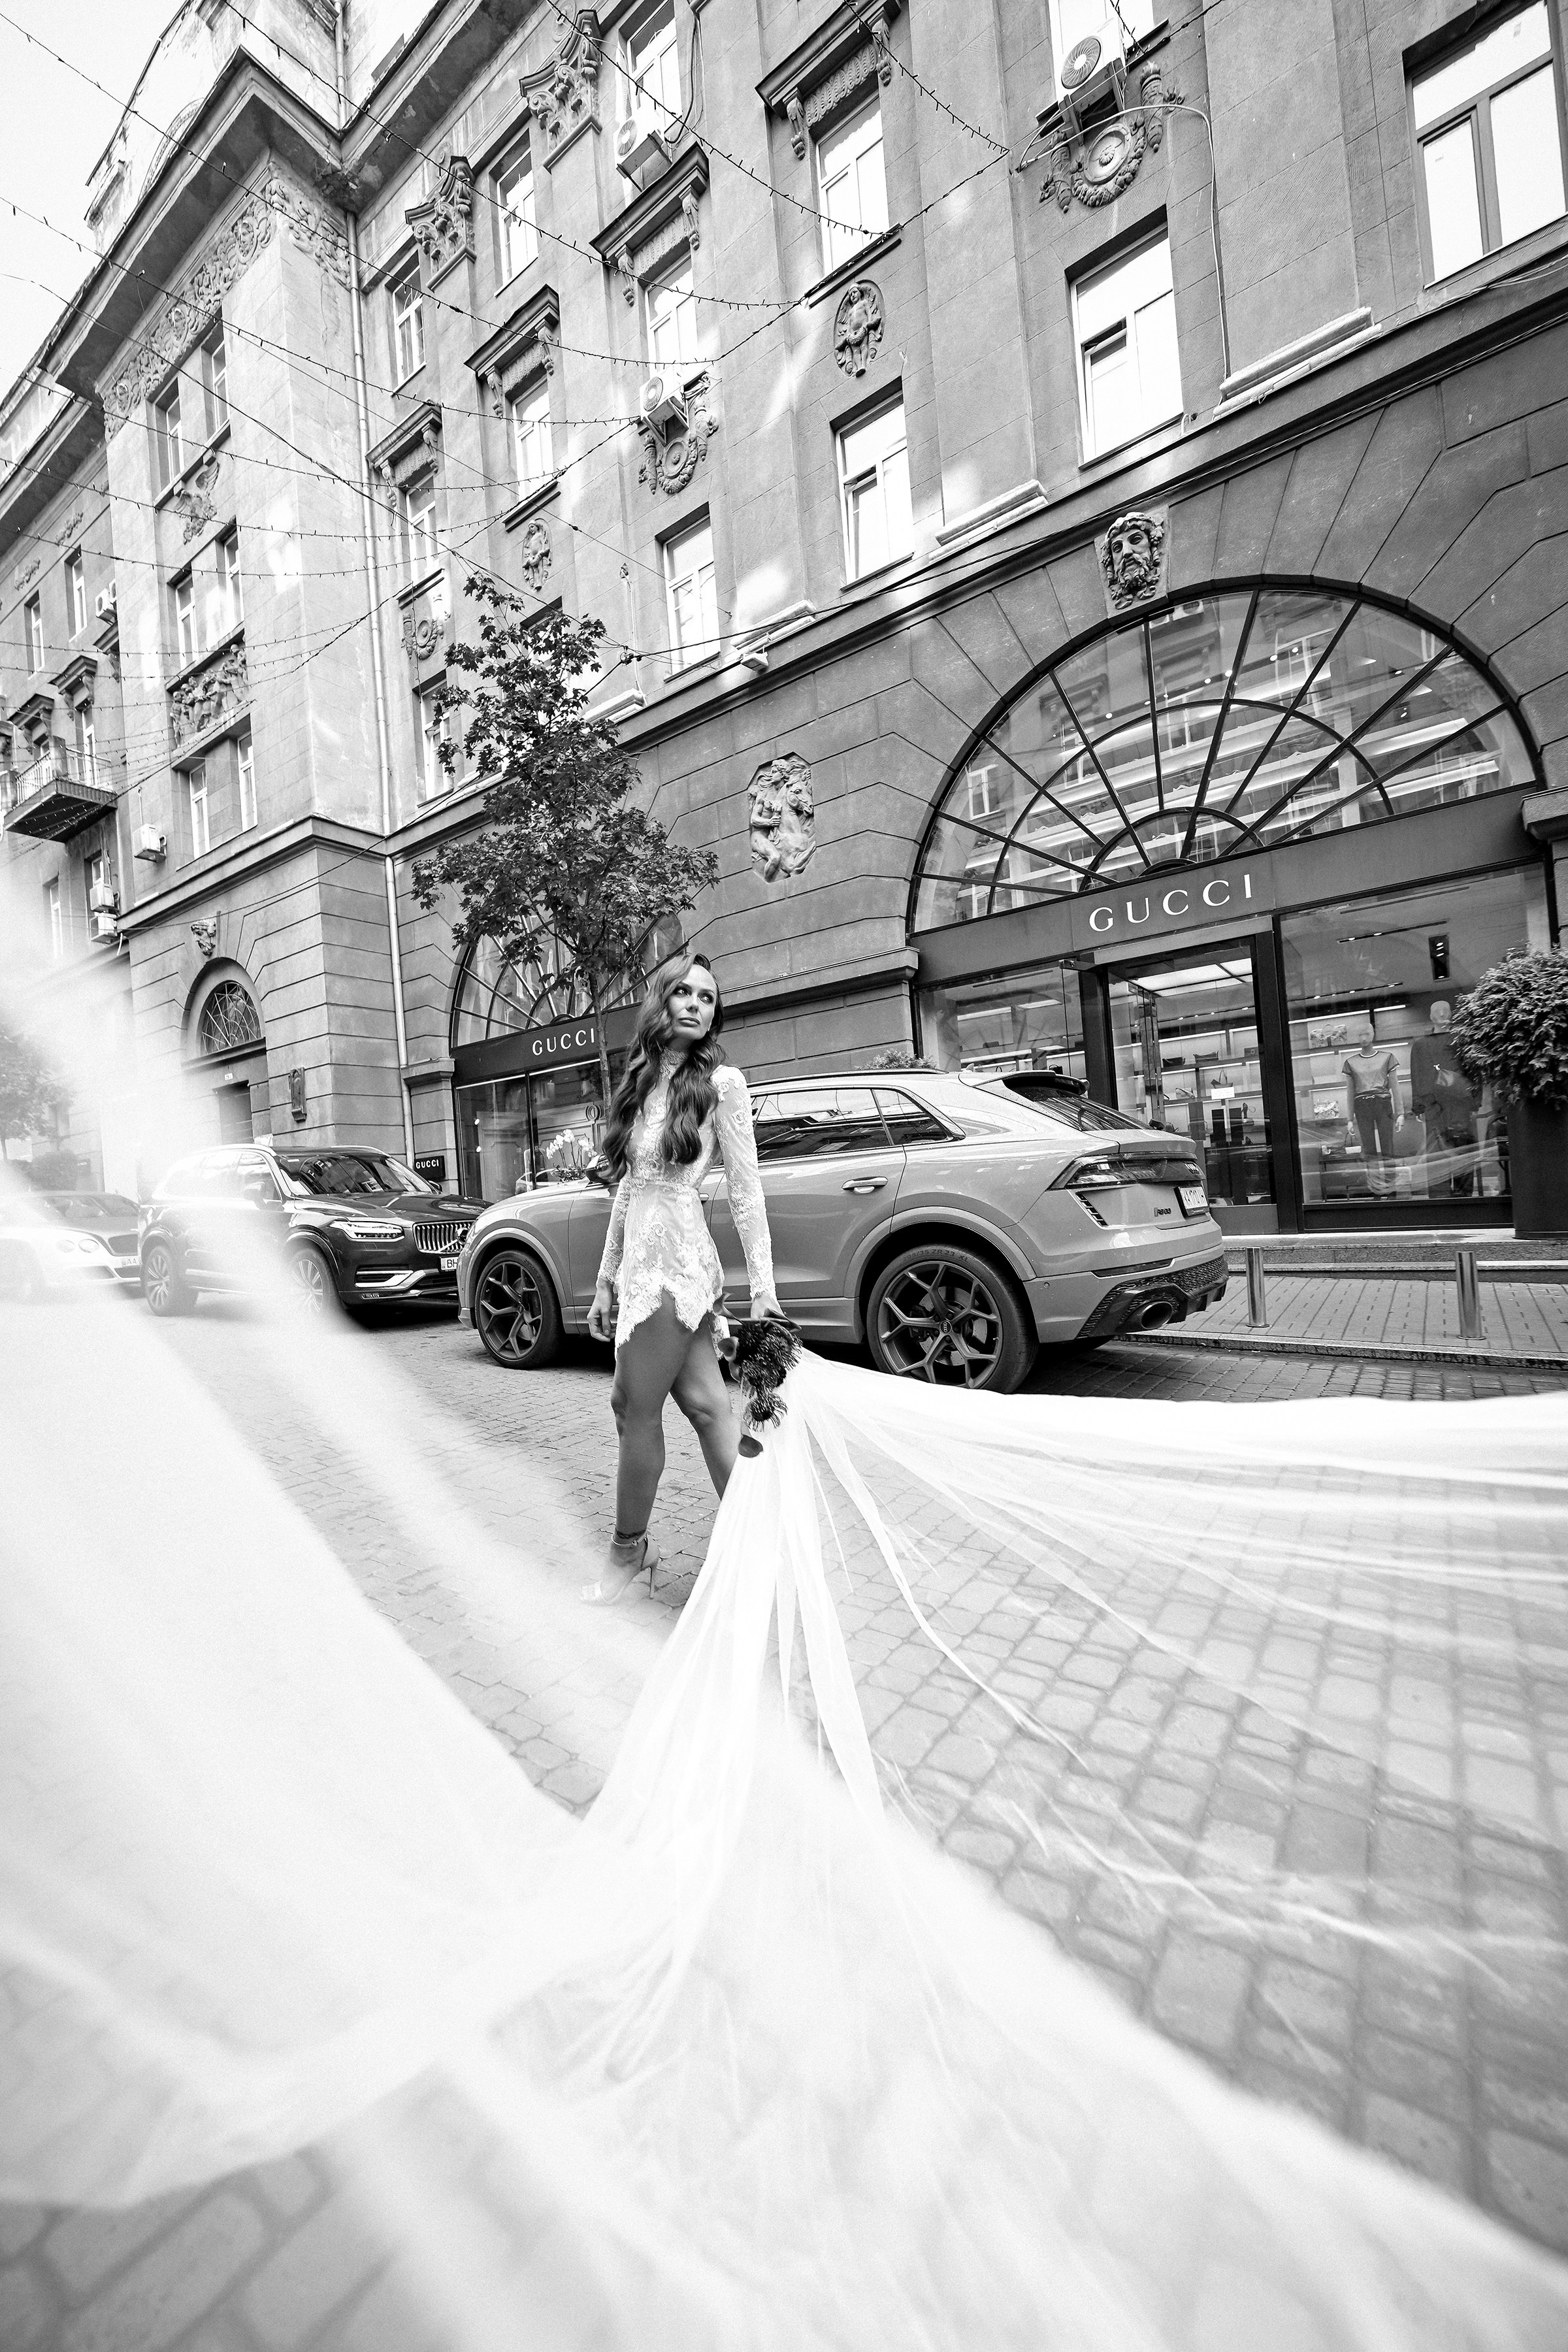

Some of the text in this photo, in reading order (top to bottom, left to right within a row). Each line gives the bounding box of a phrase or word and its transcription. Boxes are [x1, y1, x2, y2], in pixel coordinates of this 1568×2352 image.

[1089, 874, 1252, 932] GUCCI
[531, 1028, 595, 1056] GUCCI
[416, 1159, 439, 1169] GUCCI
